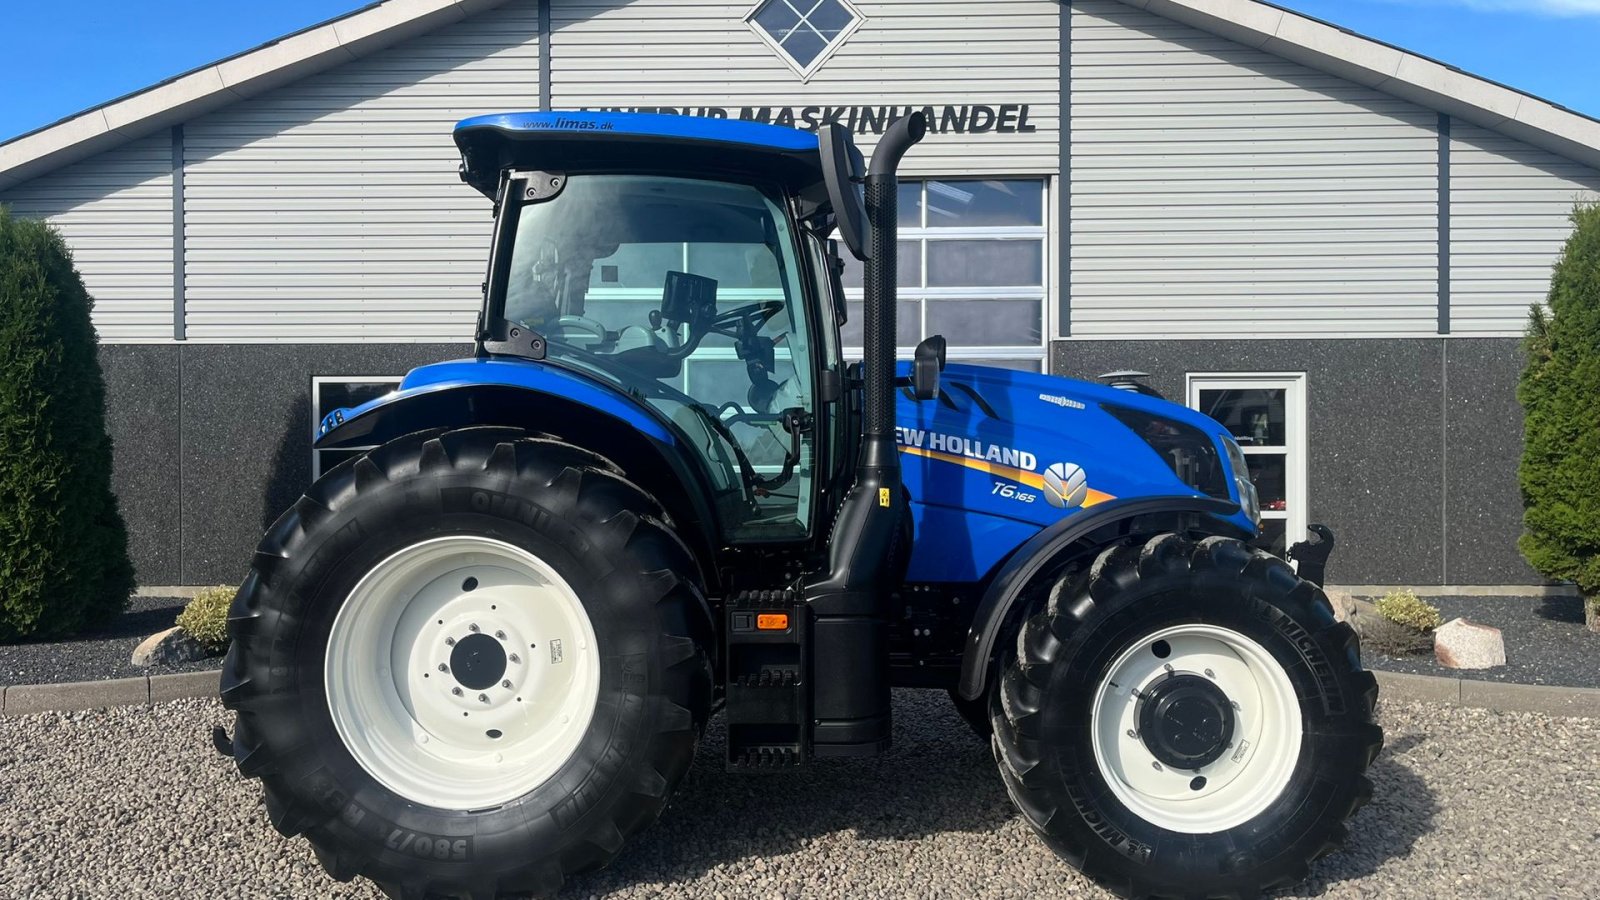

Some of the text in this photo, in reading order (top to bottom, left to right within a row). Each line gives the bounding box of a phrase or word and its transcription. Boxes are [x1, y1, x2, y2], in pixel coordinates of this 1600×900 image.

[523, 118, 614, 130] www.limas.dk
[895, 427, 1037, 471] EW HOLLAND
[991, 481, 1037, 503] T6.165
